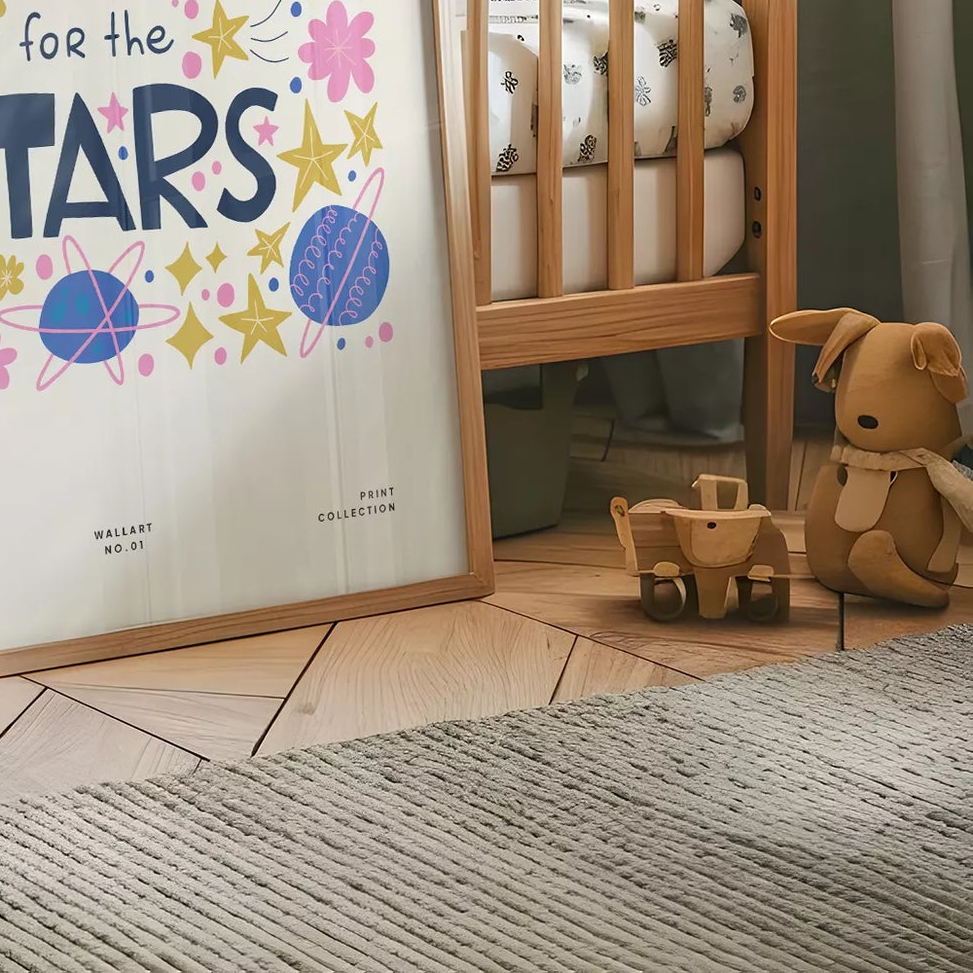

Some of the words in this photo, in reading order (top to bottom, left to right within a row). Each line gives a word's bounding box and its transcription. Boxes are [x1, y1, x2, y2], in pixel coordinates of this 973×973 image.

[103, 9, 175, 58] the
[359, 486, 394, 501] PRINT
[317, 502, 396, 523] COLLECTION
[93, 522, 153, 540] WALLART
